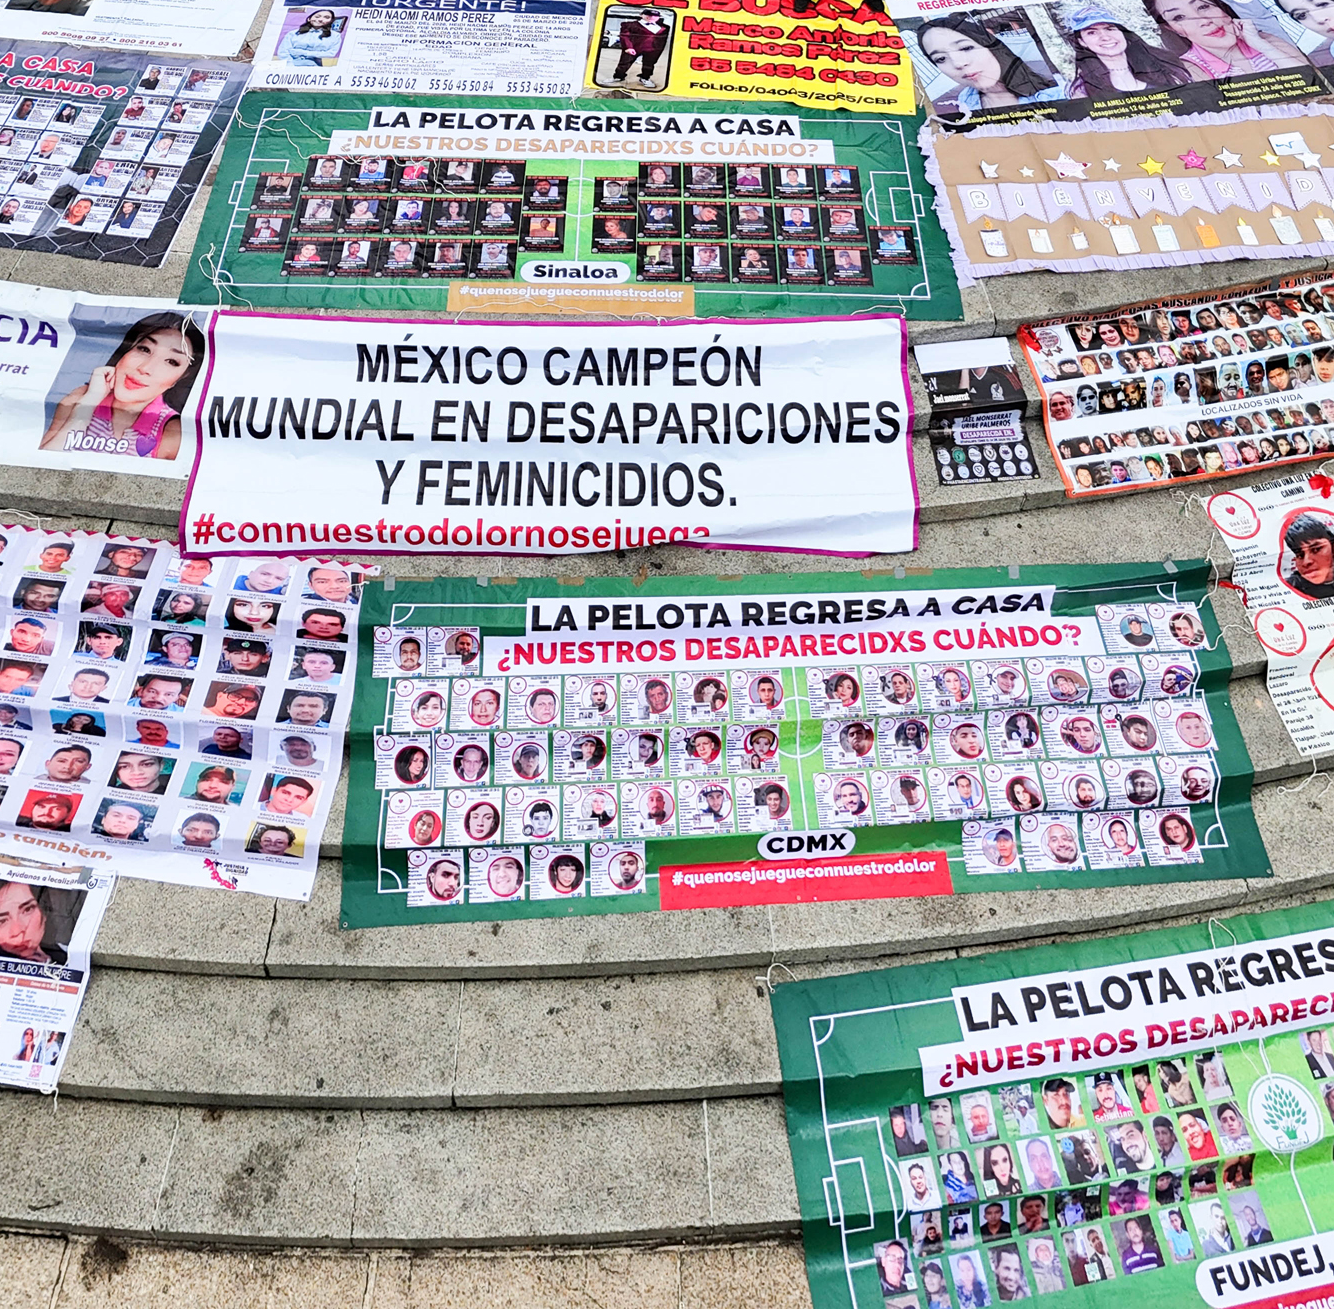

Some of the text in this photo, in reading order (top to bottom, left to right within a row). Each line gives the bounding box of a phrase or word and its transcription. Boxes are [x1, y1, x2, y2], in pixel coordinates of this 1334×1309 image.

[354, 7, 495, 25] HEIDI NAOMI RAMOS PEREZ
[682, 16, 784, 39] Marco
[689, 33, 803, 57] Ramos
[690, 57, 899, 87] 55 5484 0430
[373, 111, 795, 137] LA PELOTA REGRESA A CASA
[341, 135, 819, 158] ¿NUESTROS DESAPARECIDXS CUÁNDO?
[532, 264, 618, 280] Sinaloa
[458, 285, 684, 302] #quenosejuegueconnuestrodolor
[355, 332, 762, 388] MÉXICO CAMPEÓN
[209, 395, 899, 446] MUNDIAL EN DESAPARICIONES
[64, 430, 129, 453] Monse
[374, 459, 738, 509] Y FEMINICIDIOS.
[530, 593, 1046, 632] LA PELOTA REGRESA A CASA
[497, 628, 926, 672] ¿NUESTROS DESAPARECIDXS
[765, 832, 847, 854] CDMX
[671, 859, 937, 887] #quenosejuegueconnuestrodolor
[960, 993, 1017, 1033] LA
[1026, 968, 1189, 1023] PELOTA
